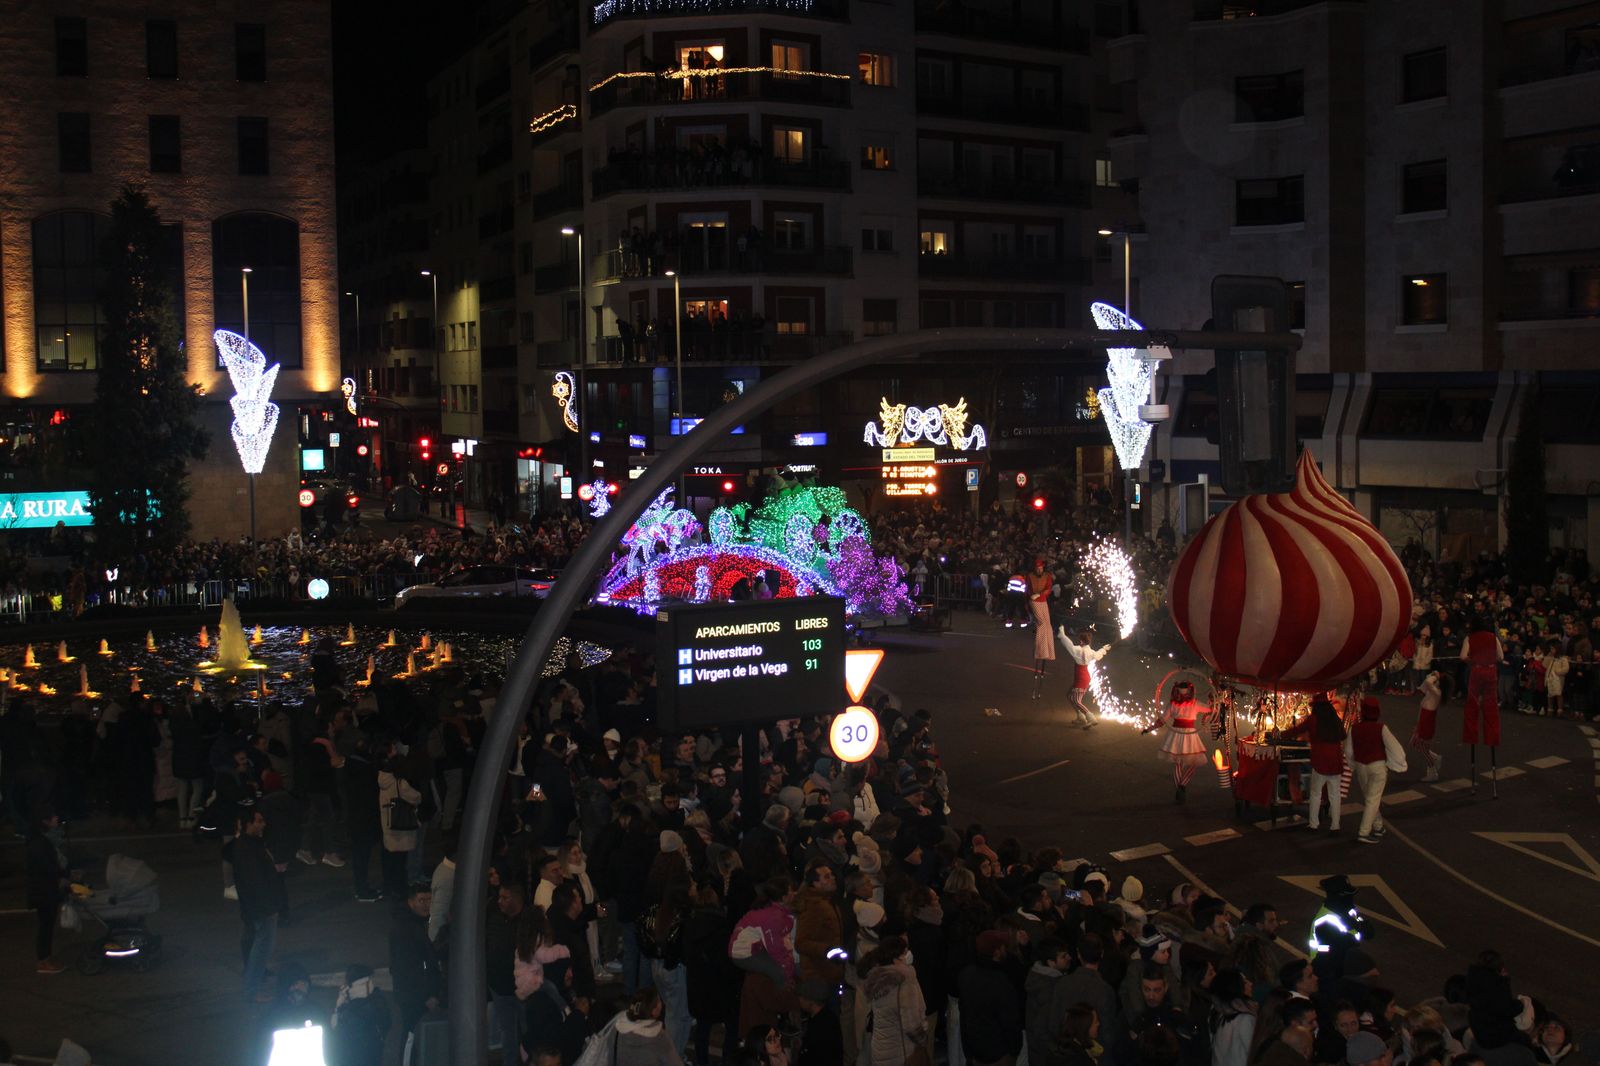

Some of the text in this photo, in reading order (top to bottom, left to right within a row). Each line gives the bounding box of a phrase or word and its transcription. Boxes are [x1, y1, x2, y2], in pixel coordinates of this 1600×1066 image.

[968, 471, 976, 484] P
[695, 617, 828, 638] APARCAMIENTOS LIBRES
[695, 645, 763, 661] Universitario
[802, 639, 822, 651] 103
[695, 666, 731, 682] Virgen
[732, 665, 746, 677] de
[748, 664, 758, 676] la
[761, 662, 788, 676] Vega
[805, 659, 818, 670] 91
[841, 725, 868, 743] 30
